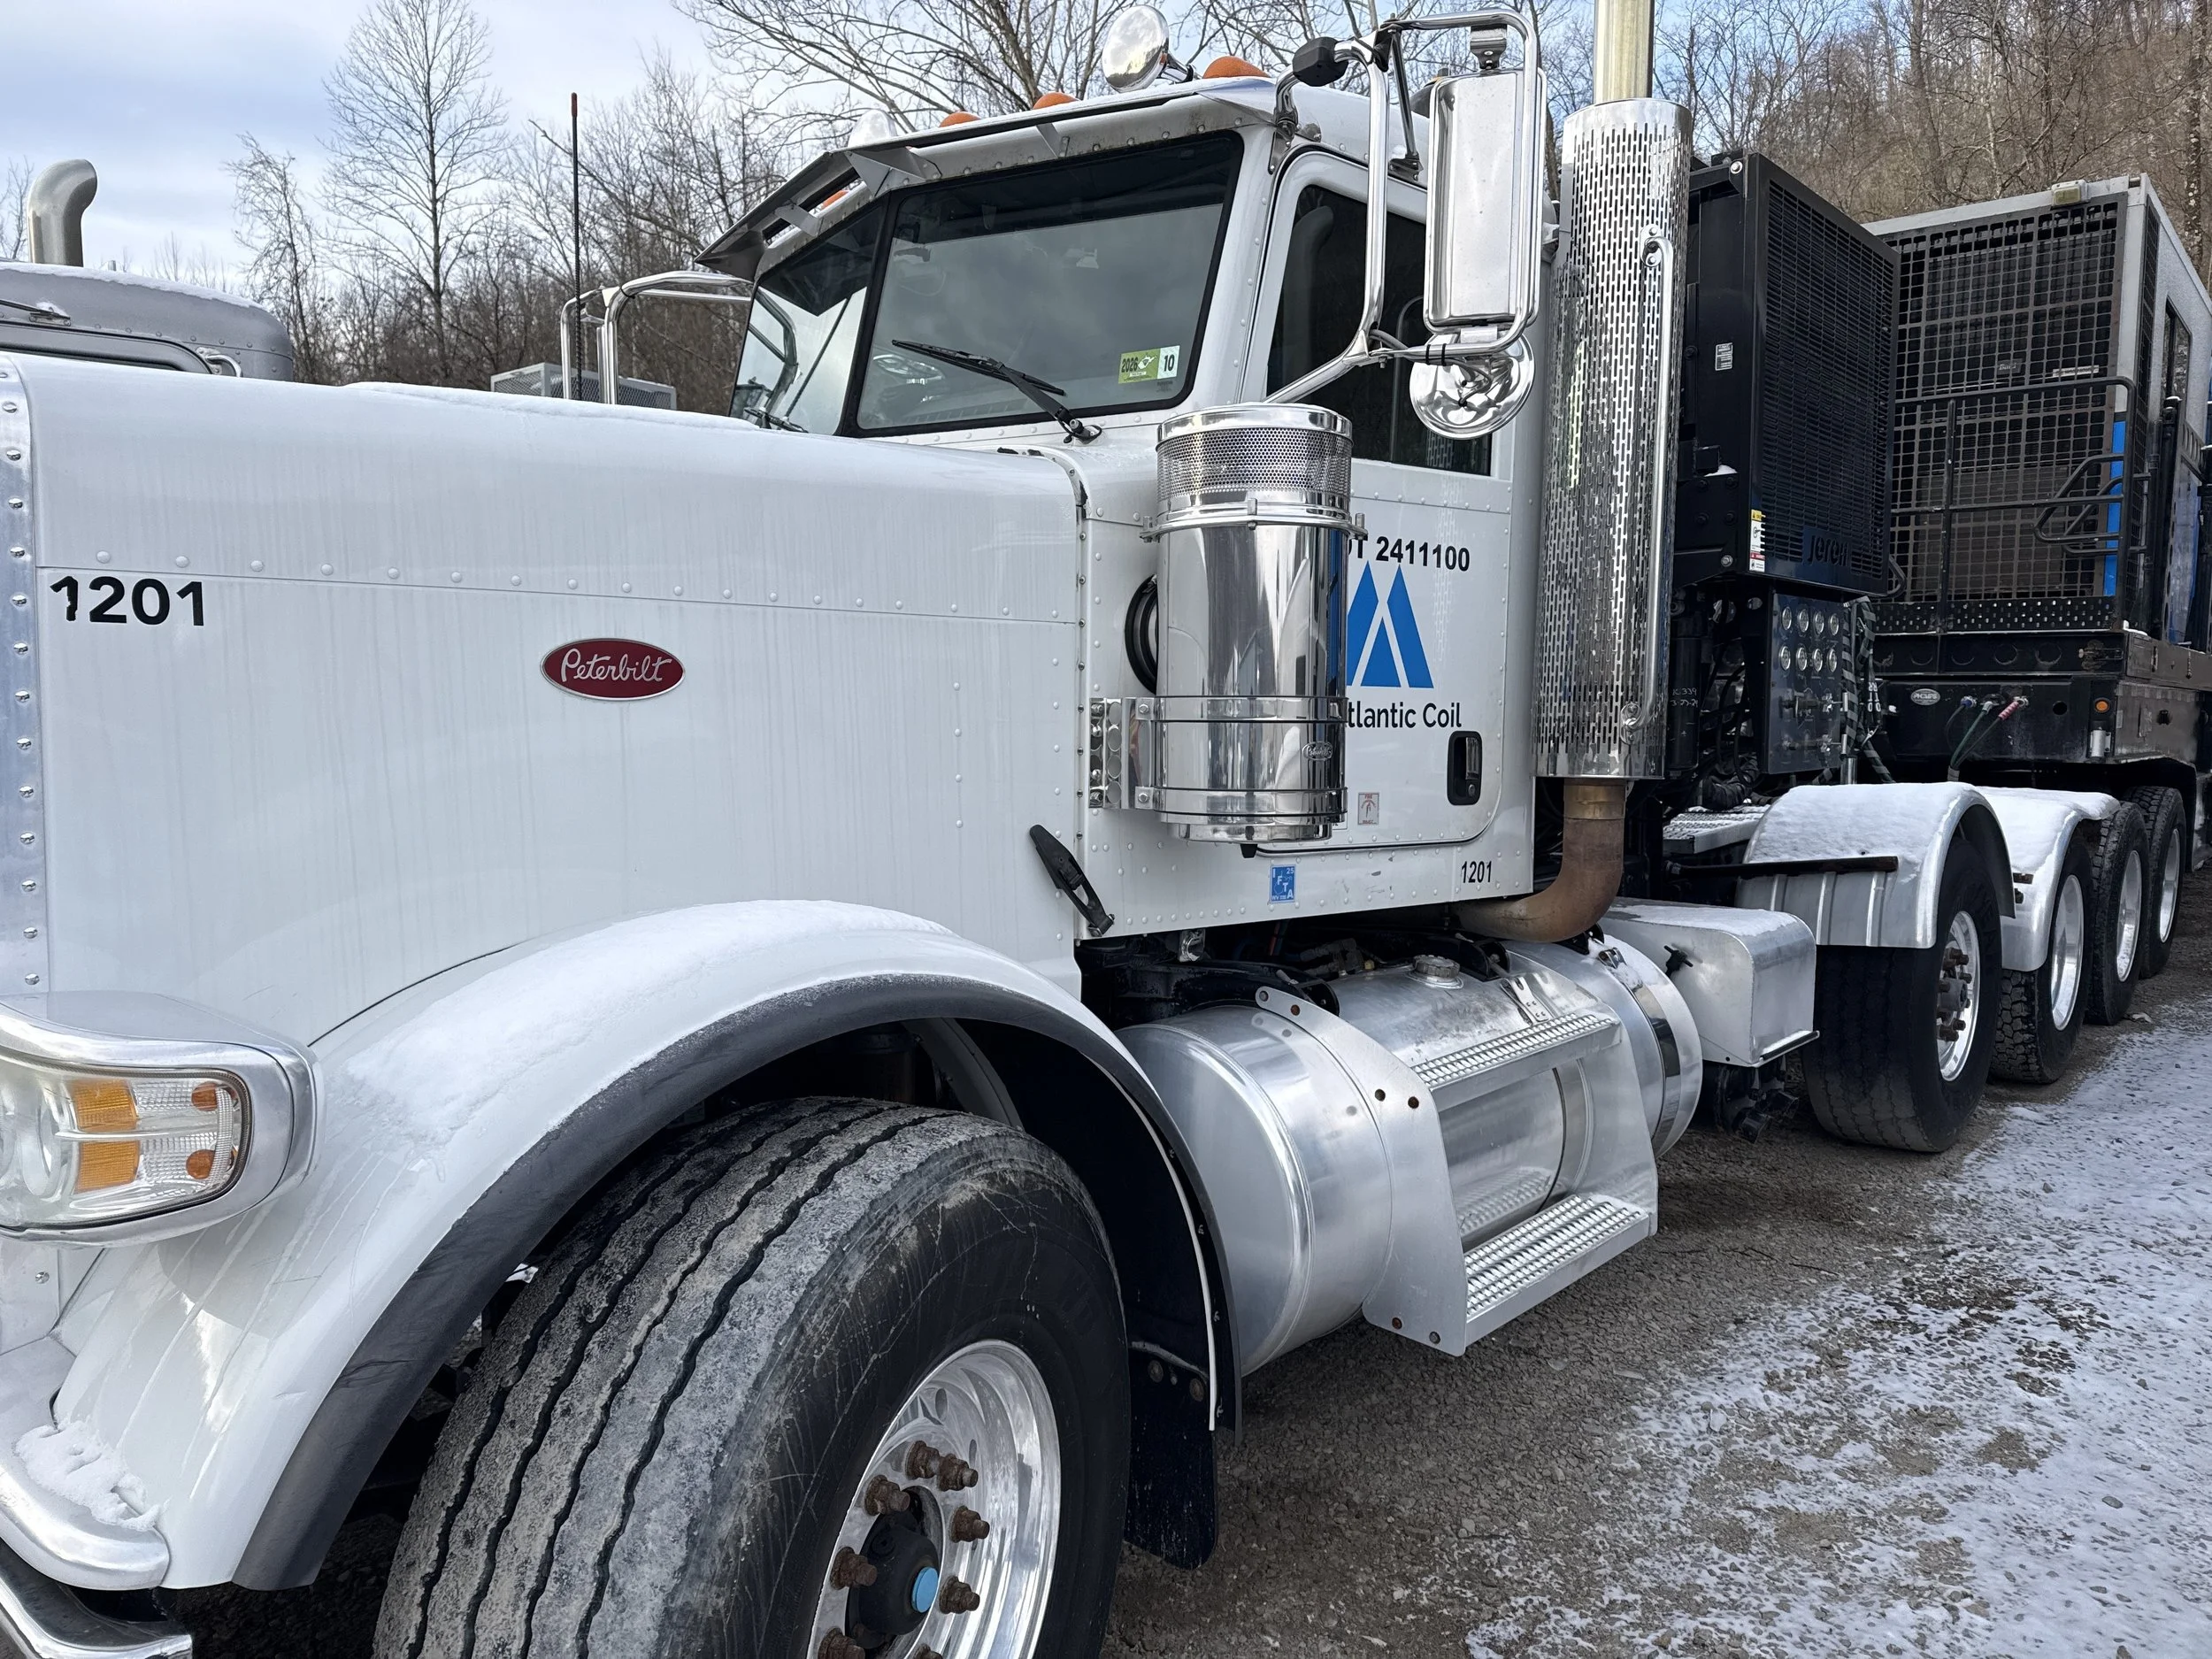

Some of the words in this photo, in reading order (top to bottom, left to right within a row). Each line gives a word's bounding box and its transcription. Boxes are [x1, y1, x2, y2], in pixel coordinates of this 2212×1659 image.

[1121, 357, 1138, 373] 2026
[1164, 354, 1175, 372] 10
[1348, 534, 1368, 558] T
[1375, 535, 1471, 572] 2411100
[50, 575, 204, 626] 1201
[560, 648, 672, 683] Peterbilt
[1348, 700, 1417, 728] tlantic
[1423, 702, 1463, 728] Coil
[1461, 860, 1493, 884] 1201
